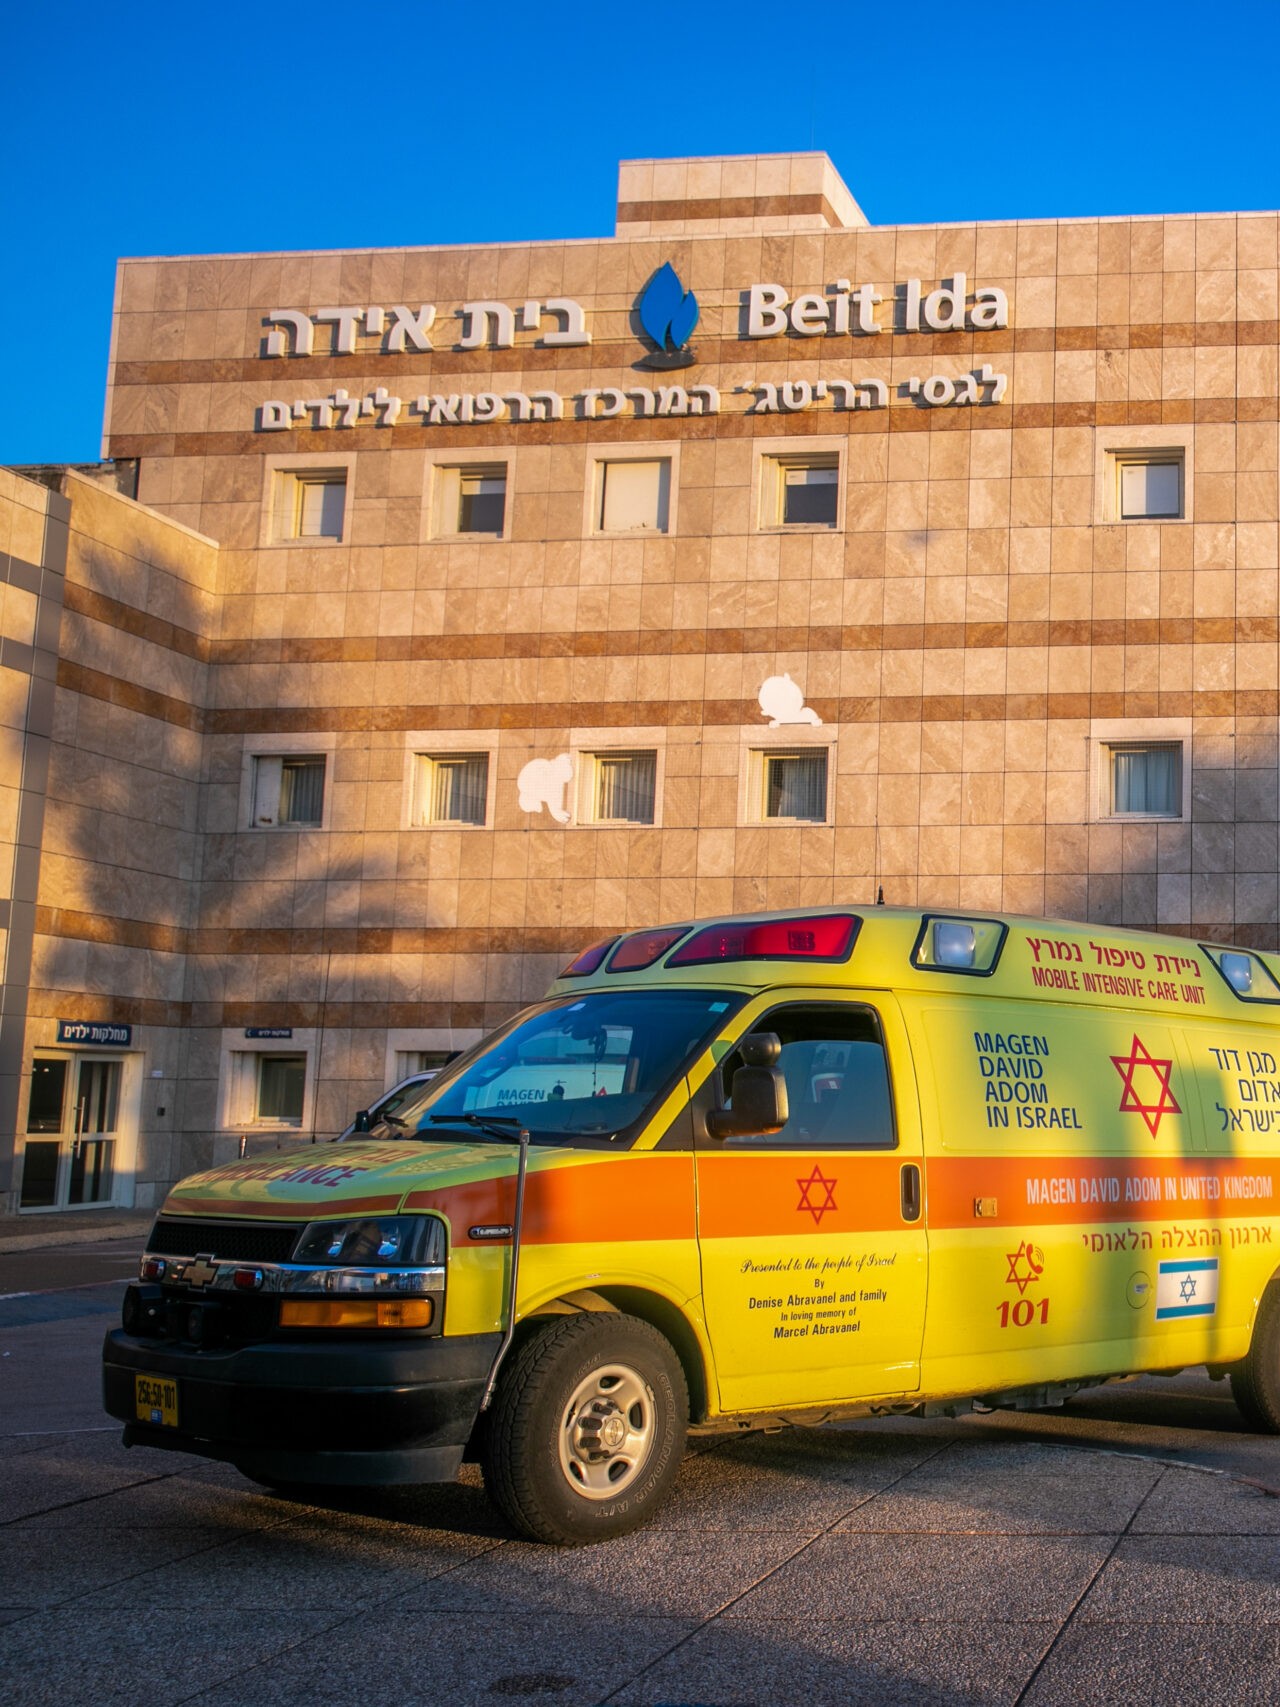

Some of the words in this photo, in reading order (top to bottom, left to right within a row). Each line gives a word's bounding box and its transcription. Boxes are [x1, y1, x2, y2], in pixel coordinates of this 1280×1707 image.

[749, 278, 883, 338] Beit
[905, 272, 1008, 332] Ida
[266, 303, 437, 357] אידה
[459, 298, 593, 350] בית
[907, 363, 1008, 408] לגסי
[261, 386, 402, 432] לילדים
[416, 390, 564, 425] הרפואי
[580, 383, 722, 418] המרכז
[1025, 936, 1083, 963] נמרץ
[1088, 941, 1146, 970] טיפול
[1153, 953, 1202, 978] ניידת
[1031, 966, 1080, 991] MOBILE
[1082, 972, 1145, 998] INTENSIVE
[1148, 980, 1179, 1002] CARE
[1181, 985, 1206, 1005] UNIT
[63, 1024, 90, 1039] ילדים
[974, 1032, 1049, 1056] MAGEN
[978, 1056, 1043, 1080] DAVID
[1208, 1047, 1242, 1073] דוד
[1247, 1052, 1277, 1075] מגן
[497, 1088, 545, 1101] MAGEN
[985, 1081, 1049, 1103] ADOM
[986, 1106, 1009, 1128] IN
[1017, 1106, 1083, 1129] ISRAEL
[1026, 1178, 1076, 1205] MAGEN
[1080, 1178, 1121, 1204] DAVID
[1125, 1177, 1161, 1201] ADOM
[1164, 1177, 1177, 1200] IN
[1180, 1176, 1221, 1200] UNITED
[1224, 1175, 1273, 1199] KINGDOM
[1082, 1227, 1153, 1253] הלאומי
[1161, 1226, 1222, 1250] ההצלה
[1228, 1225, 1273, 1249] ארגון
[740, 1257, 793, 1274] Presented
[793, 1257, 803, 1271] to
[804, 1256, 820, 1270] the
[820, 1254, 852, 1274] people
[855, 1252, 867, 1272] of
[867, 1252, 897, 1267] Israel
[814, 1278, 825, 1290] By
[748, 1296, 783, 1309] Denise
[787, 1292, 836, 1306] Abravanel
[839, 1291, 856, 1303] and
[859, 1288, 887, 1302] family
[780, 1311, 788, 1321] In
[790, 1310, 814, 1322] loving
[816, 1308, 846, 1319] memory
[848, 1306, 857, 1316] of
[996, 1297, 1050, 1329] 101
[773, 1325, 808, 1339] Marcel
[811, 1320, 861, 1335] Abravanel
